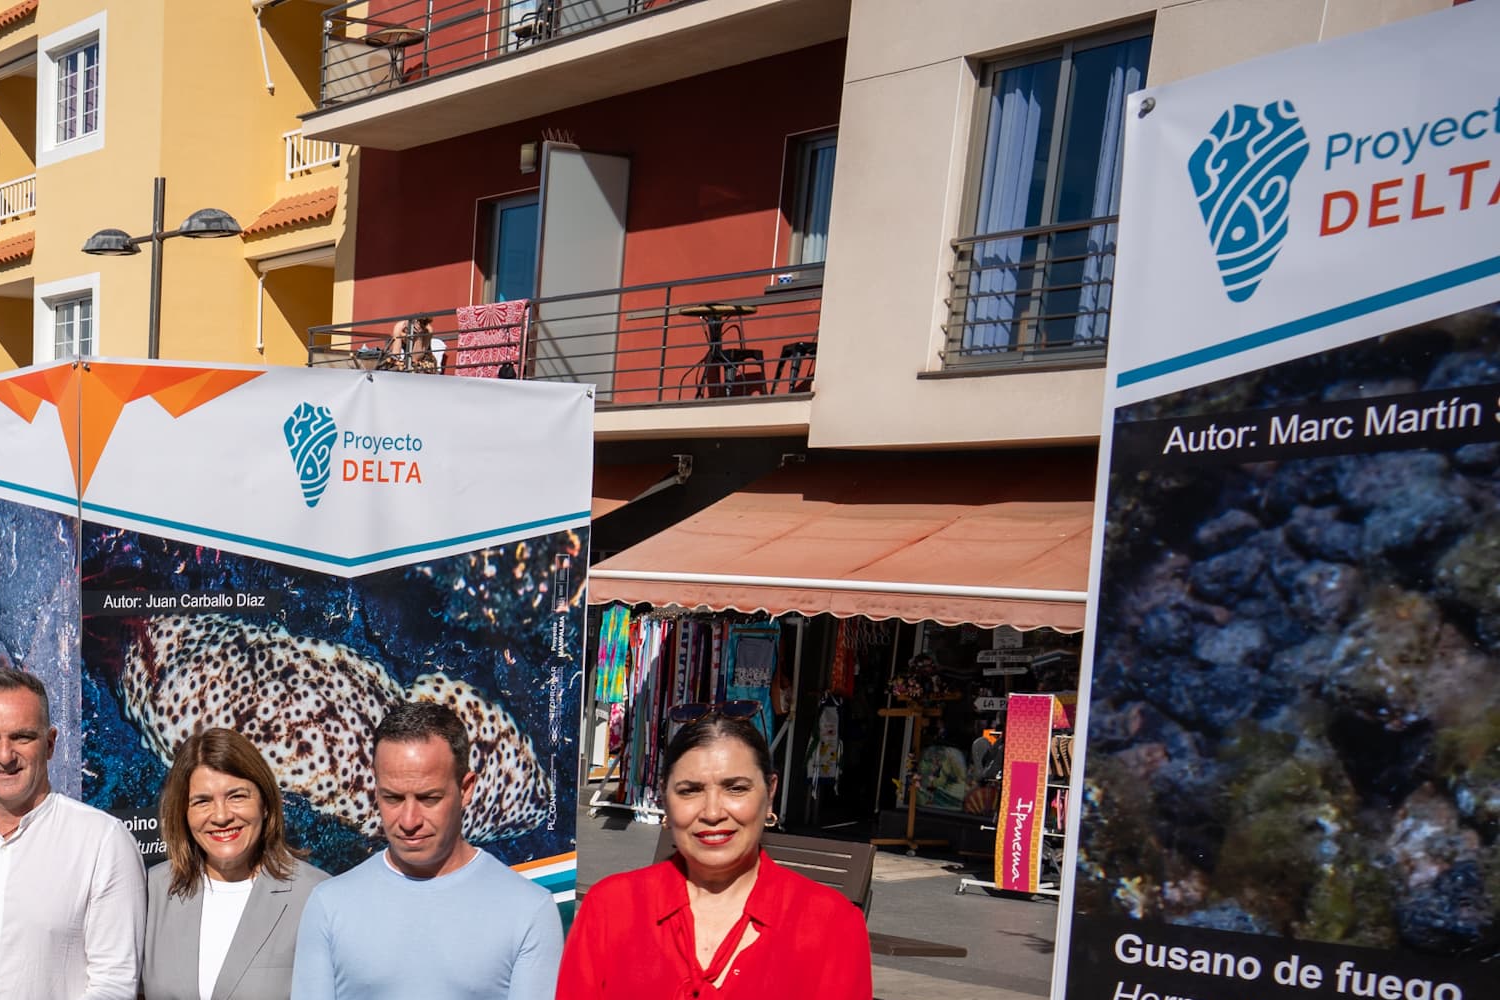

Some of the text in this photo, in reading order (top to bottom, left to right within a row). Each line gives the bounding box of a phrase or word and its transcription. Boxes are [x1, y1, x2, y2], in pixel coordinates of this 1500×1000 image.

[343, 431, 423, 455] Proyecto
[1163, 423, 1258, 455] Autor:
[1269, 413, 1353, 447] Marc
[1365, 397, 1481, 438] Martín
[342, 459, 422, 483] DELTA
[103, 593, 265, 609] Autor: Juan Carballo Díaz
[1010, 797, 1034, 883] Ipanema
[1115, 933, 1261, 981] Gusano
[1274, 955, 1322, 988] de
